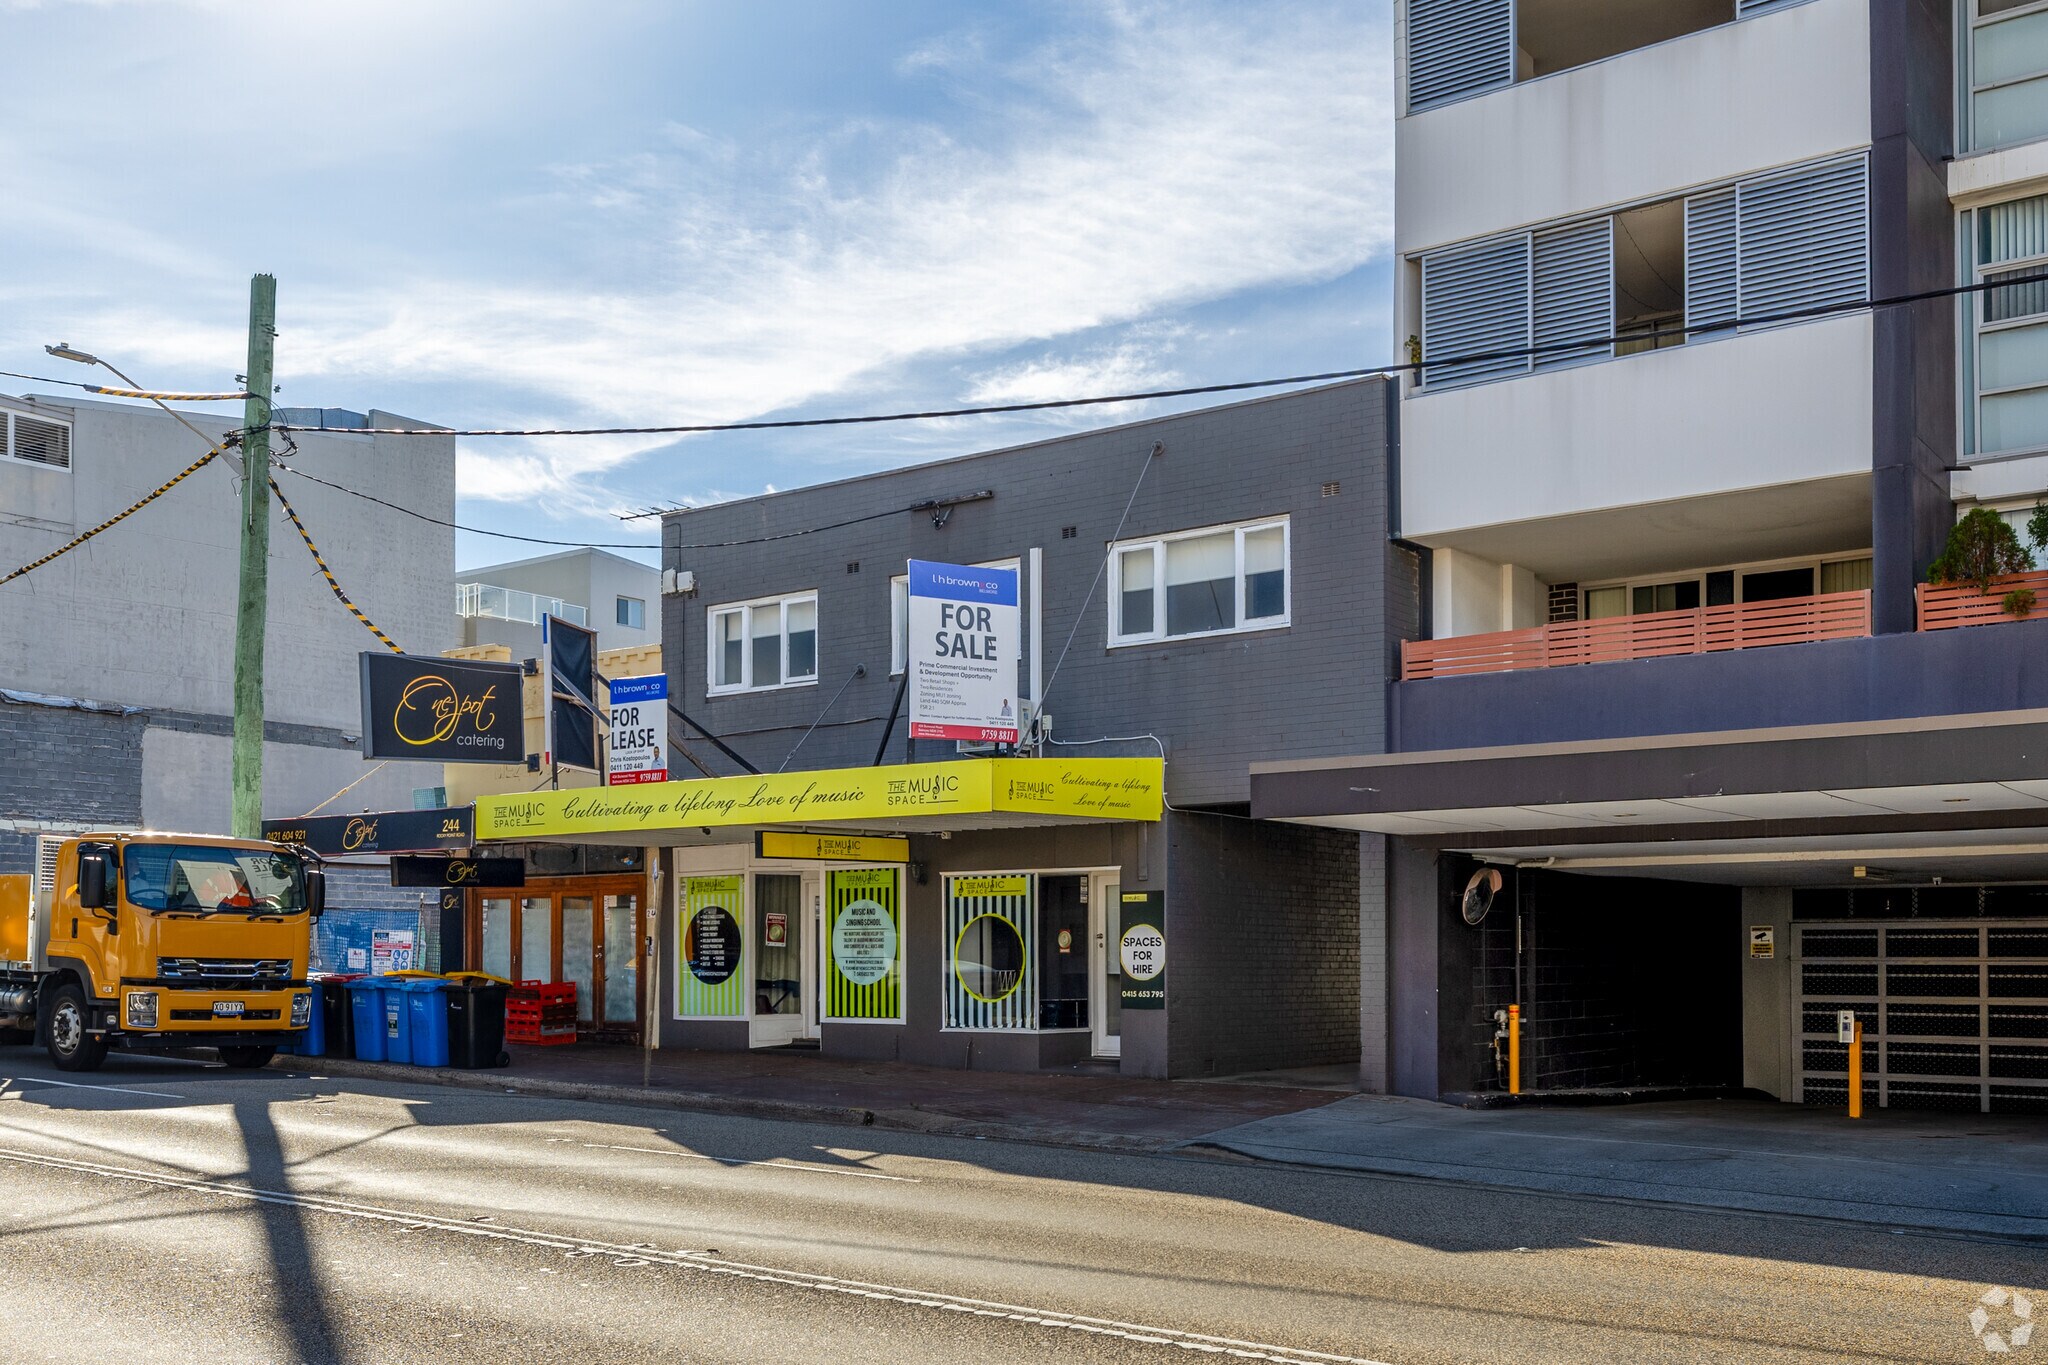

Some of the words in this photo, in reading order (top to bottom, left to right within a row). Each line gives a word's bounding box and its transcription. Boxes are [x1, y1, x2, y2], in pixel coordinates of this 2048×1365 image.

[941, 603, 992, 632] FOR
[936, 631, 998, 661] SALE
[936, 662, 968, 670] Commercial
[968, 666, 998, 674] Investment
[924, 669, 960, 678] Development
[960, 672, 992, 682] Opportunity
[612, 707, 639, 728] FOR
[612, 728, 655, 750] LEASE
[982, 729, 997, 739] 9759
[998, 730, 1014, 740] 8811
[456, 734, 504, 750] catering
[640, 773, 650, 782] 9759
[1060, 772, 1111, 791] Cultivating
[1122, 775, 1151, 794] lifelong
[888, 780, 906, 794] THE
[908, 775, 958, 797] MUSIC
[1016, 781, 1026, 791] THE
[562, 796, 654, 821] Cultivating
[658, 804, 669, 813] a
[674, 790, 737, 819] lifelong
[738, 782, 785, 808] Love
[789, 781, 817, 812] of
[812, 786, 865, 803] music
[888, 794, 925, 805] SPACE
[1073, 793, 1096, 806] Love
[1098, 796, 1108, 811] of
[1109, 800, 1131, 808] music
[494, 808, 507, 818] THE
[508, 802, 545, 820] MUSIC
[442, 819, 460, 833] 244
[494, 820, 521, 828] SPACE
[266, 832, 281, 841] 0421
[282, 830, 294, 841] 604
[294, 830, 306, 840] 921
[1123, 937, 1161, 947] SPACES
[1133, 951, 1152, 960] FOR
[1133, 965, 1152, 974] HIRE
